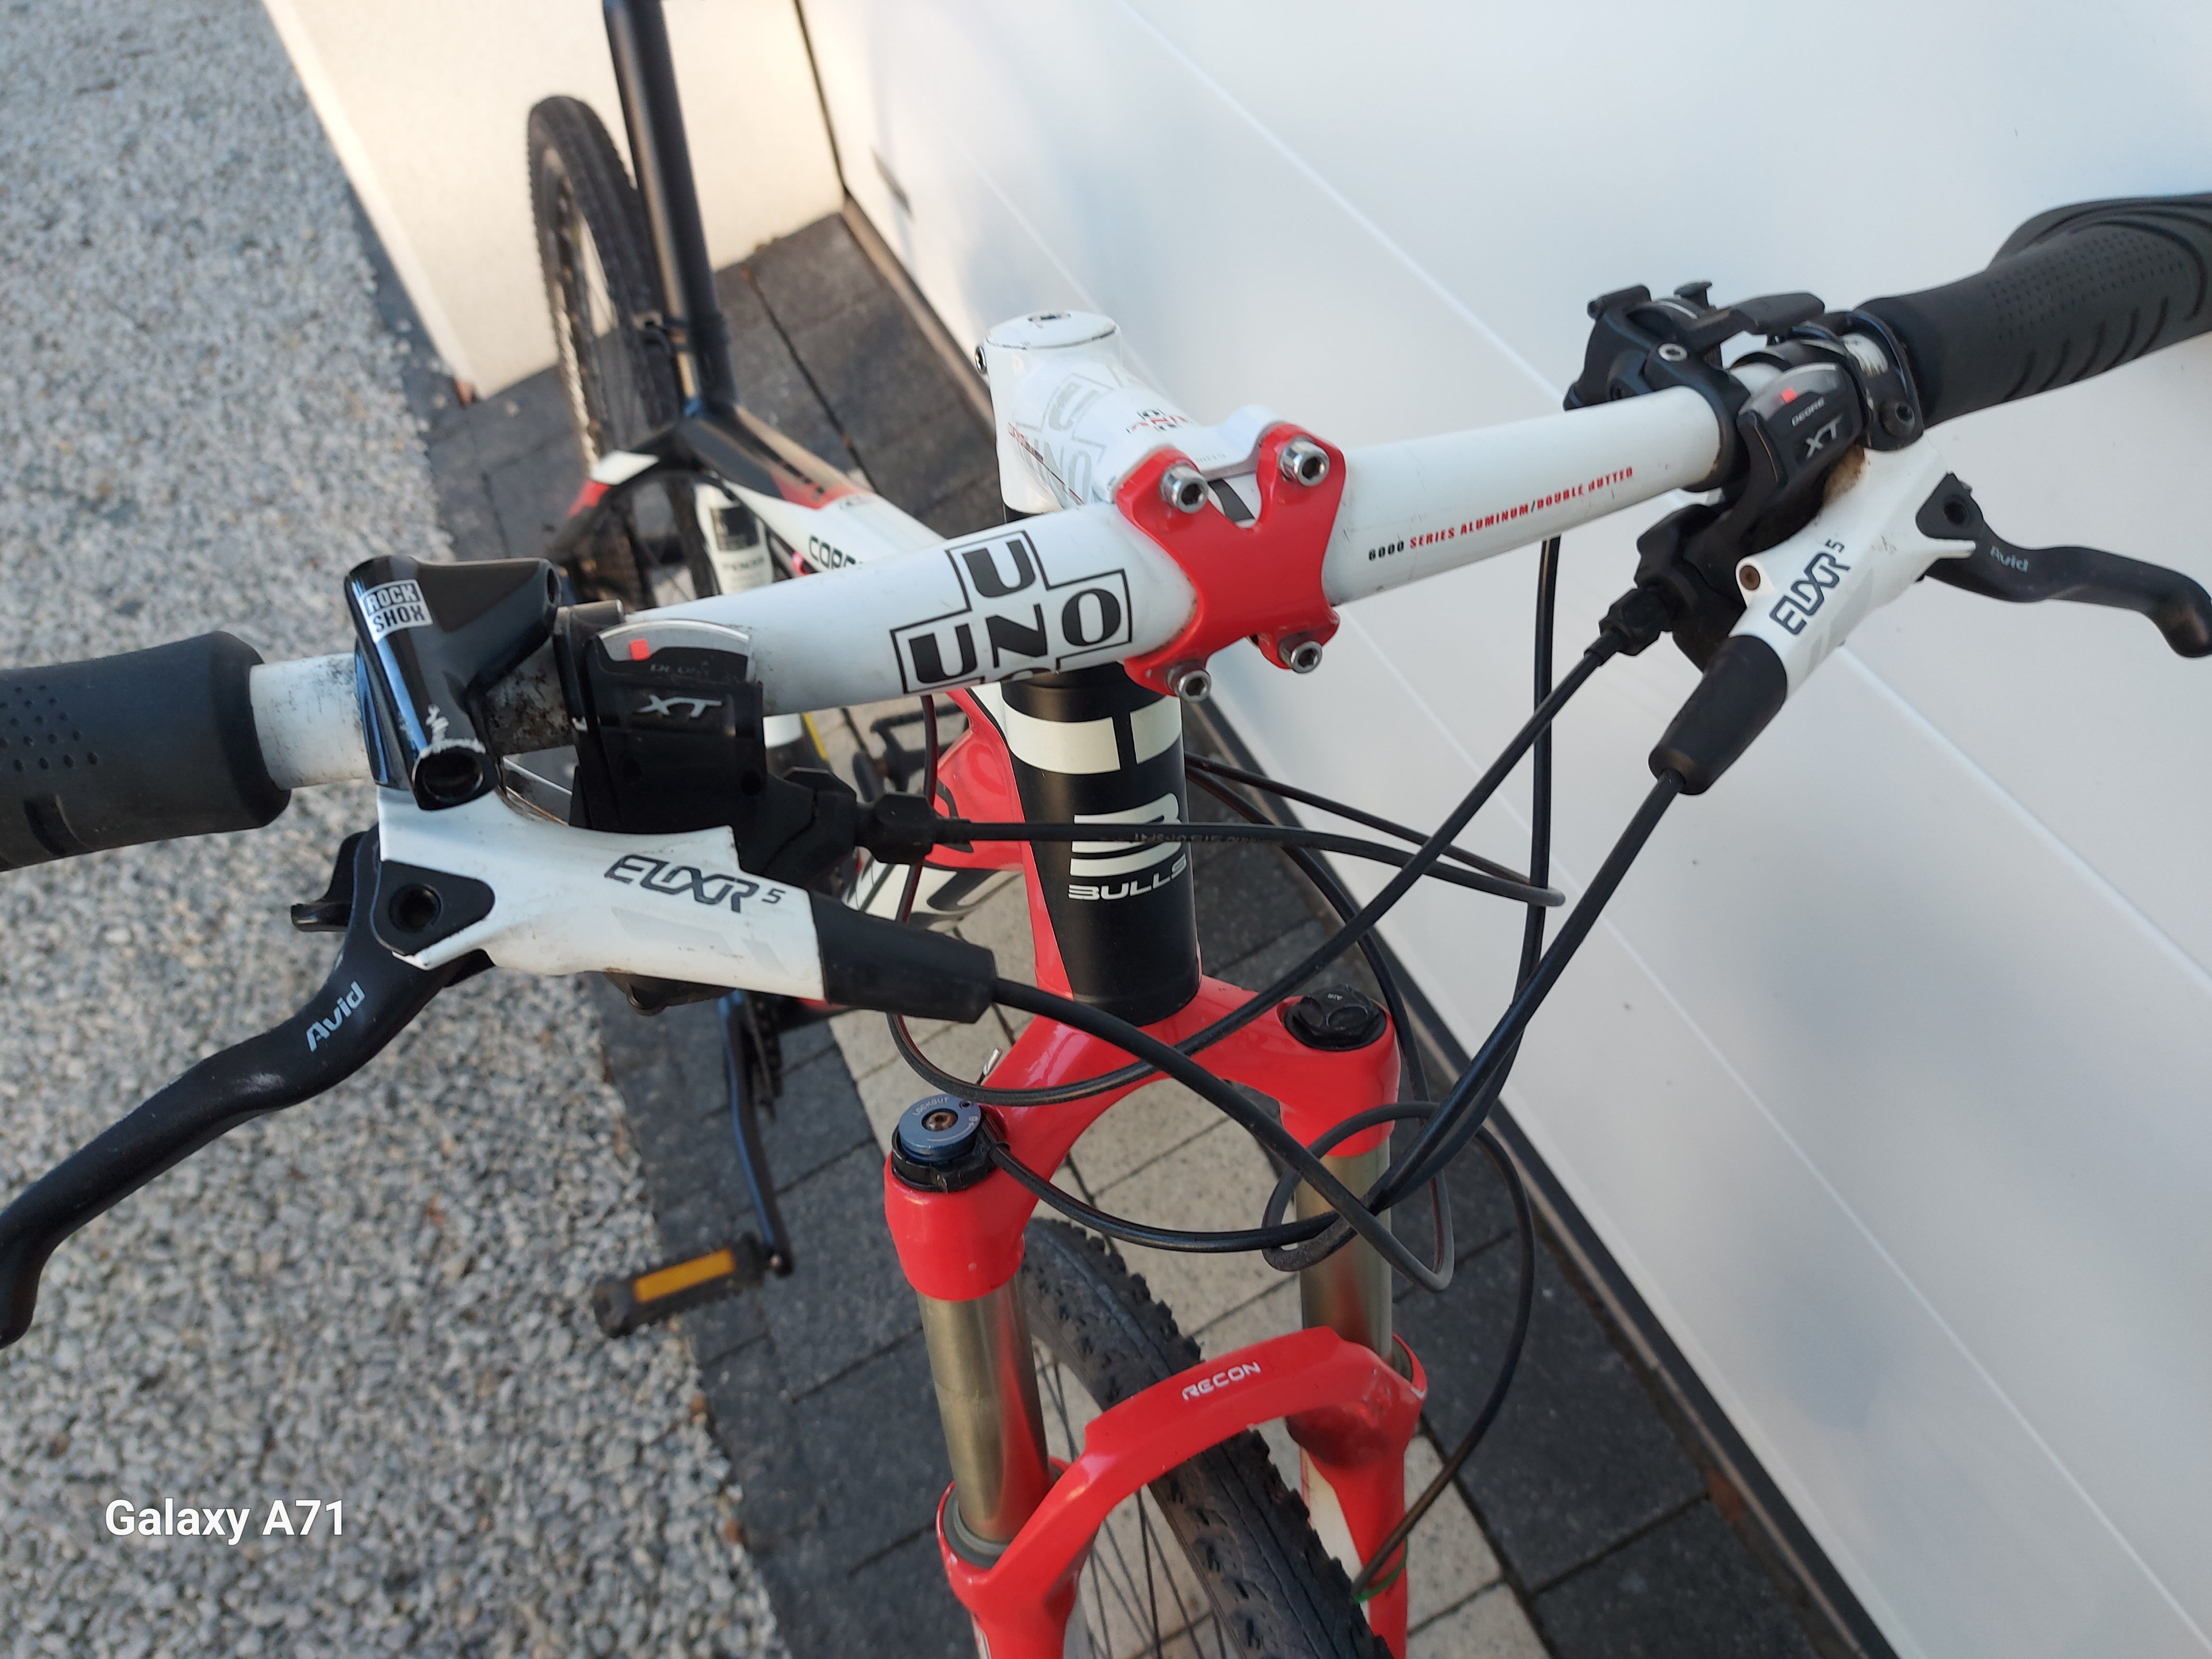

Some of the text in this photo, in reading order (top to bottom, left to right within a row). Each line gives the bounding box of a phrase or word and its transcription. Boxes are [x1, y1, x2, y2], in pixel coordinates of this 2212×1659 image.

[1805, 415, 1842, 458] XT
[1369, 541, 1405, 561] 6000
[1409, 528, 1455, 549] SERIES
[1825, 539, 1845, 553] 5
[1990, 545, 2029, 573] Avid
[366, 584, 418, 610] ROCK
[374, 606, 425, 632] SHOX
[908, 588, 1121, 683] UNO
[639, 695, 722, 718] XT
[1068, 853, 1187, 900] BULLS
[762, 888, 785, 904] 5
[306, 981, 365, 1052] Avid
[913, 1097, 948, 1116] LOCKOUT
[1182, 1361, 1261, 1401] RECON
